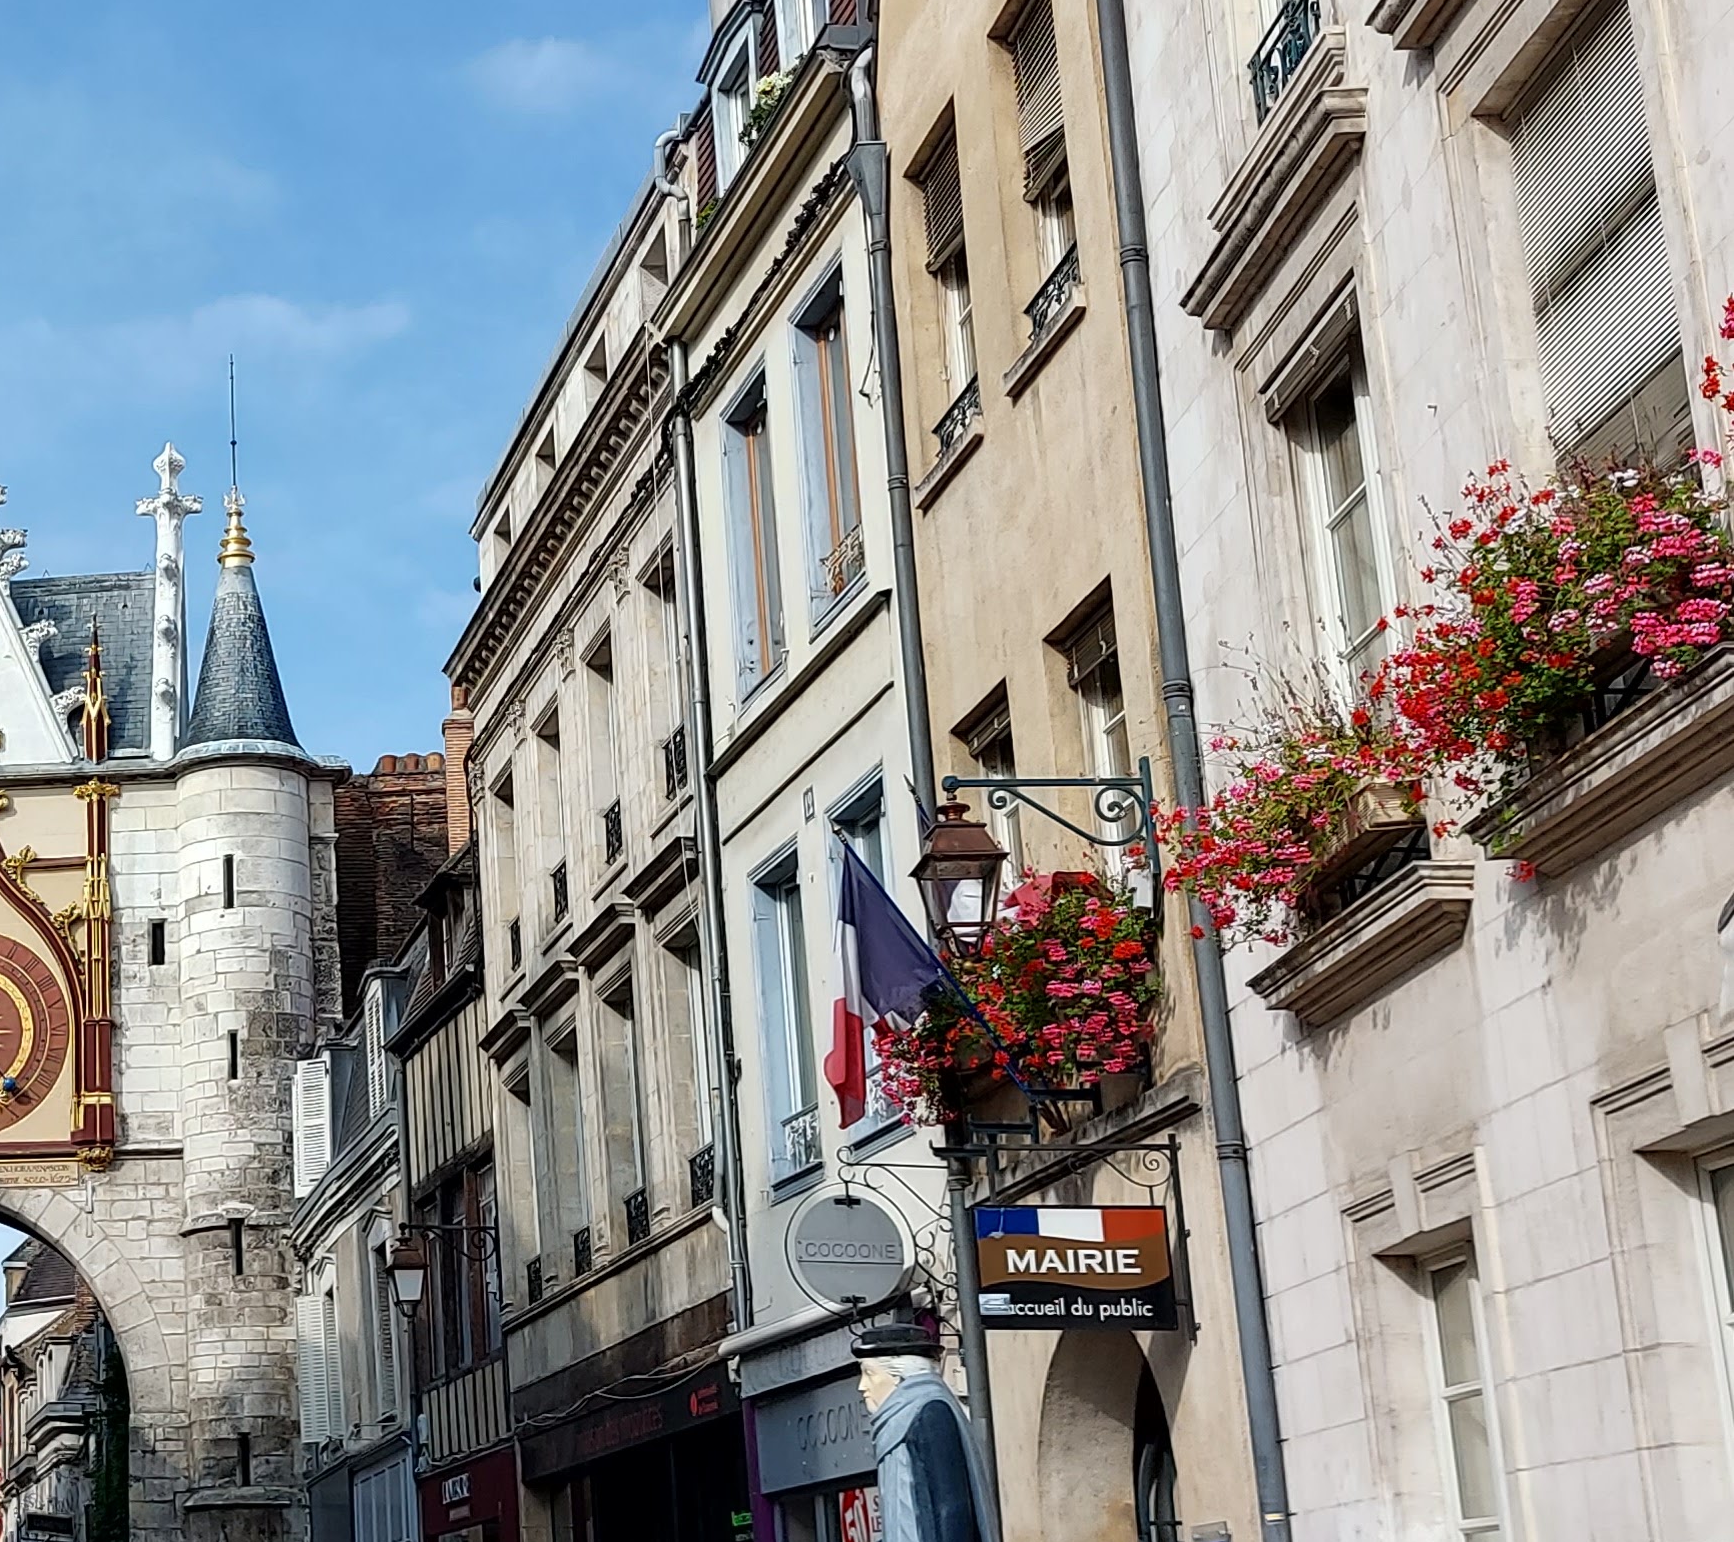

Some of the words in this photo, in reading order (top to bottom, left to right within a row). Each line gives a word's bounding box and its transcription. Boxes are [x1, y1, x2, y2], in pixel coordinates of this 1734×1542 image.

[804, 1242, 897, 1260] COCOONE
[1004, 1248, 1143, 1275] MAIRIE
[1070, 1295, 1094, 1317] du
[1098, 1296, 1155, 1322] public
